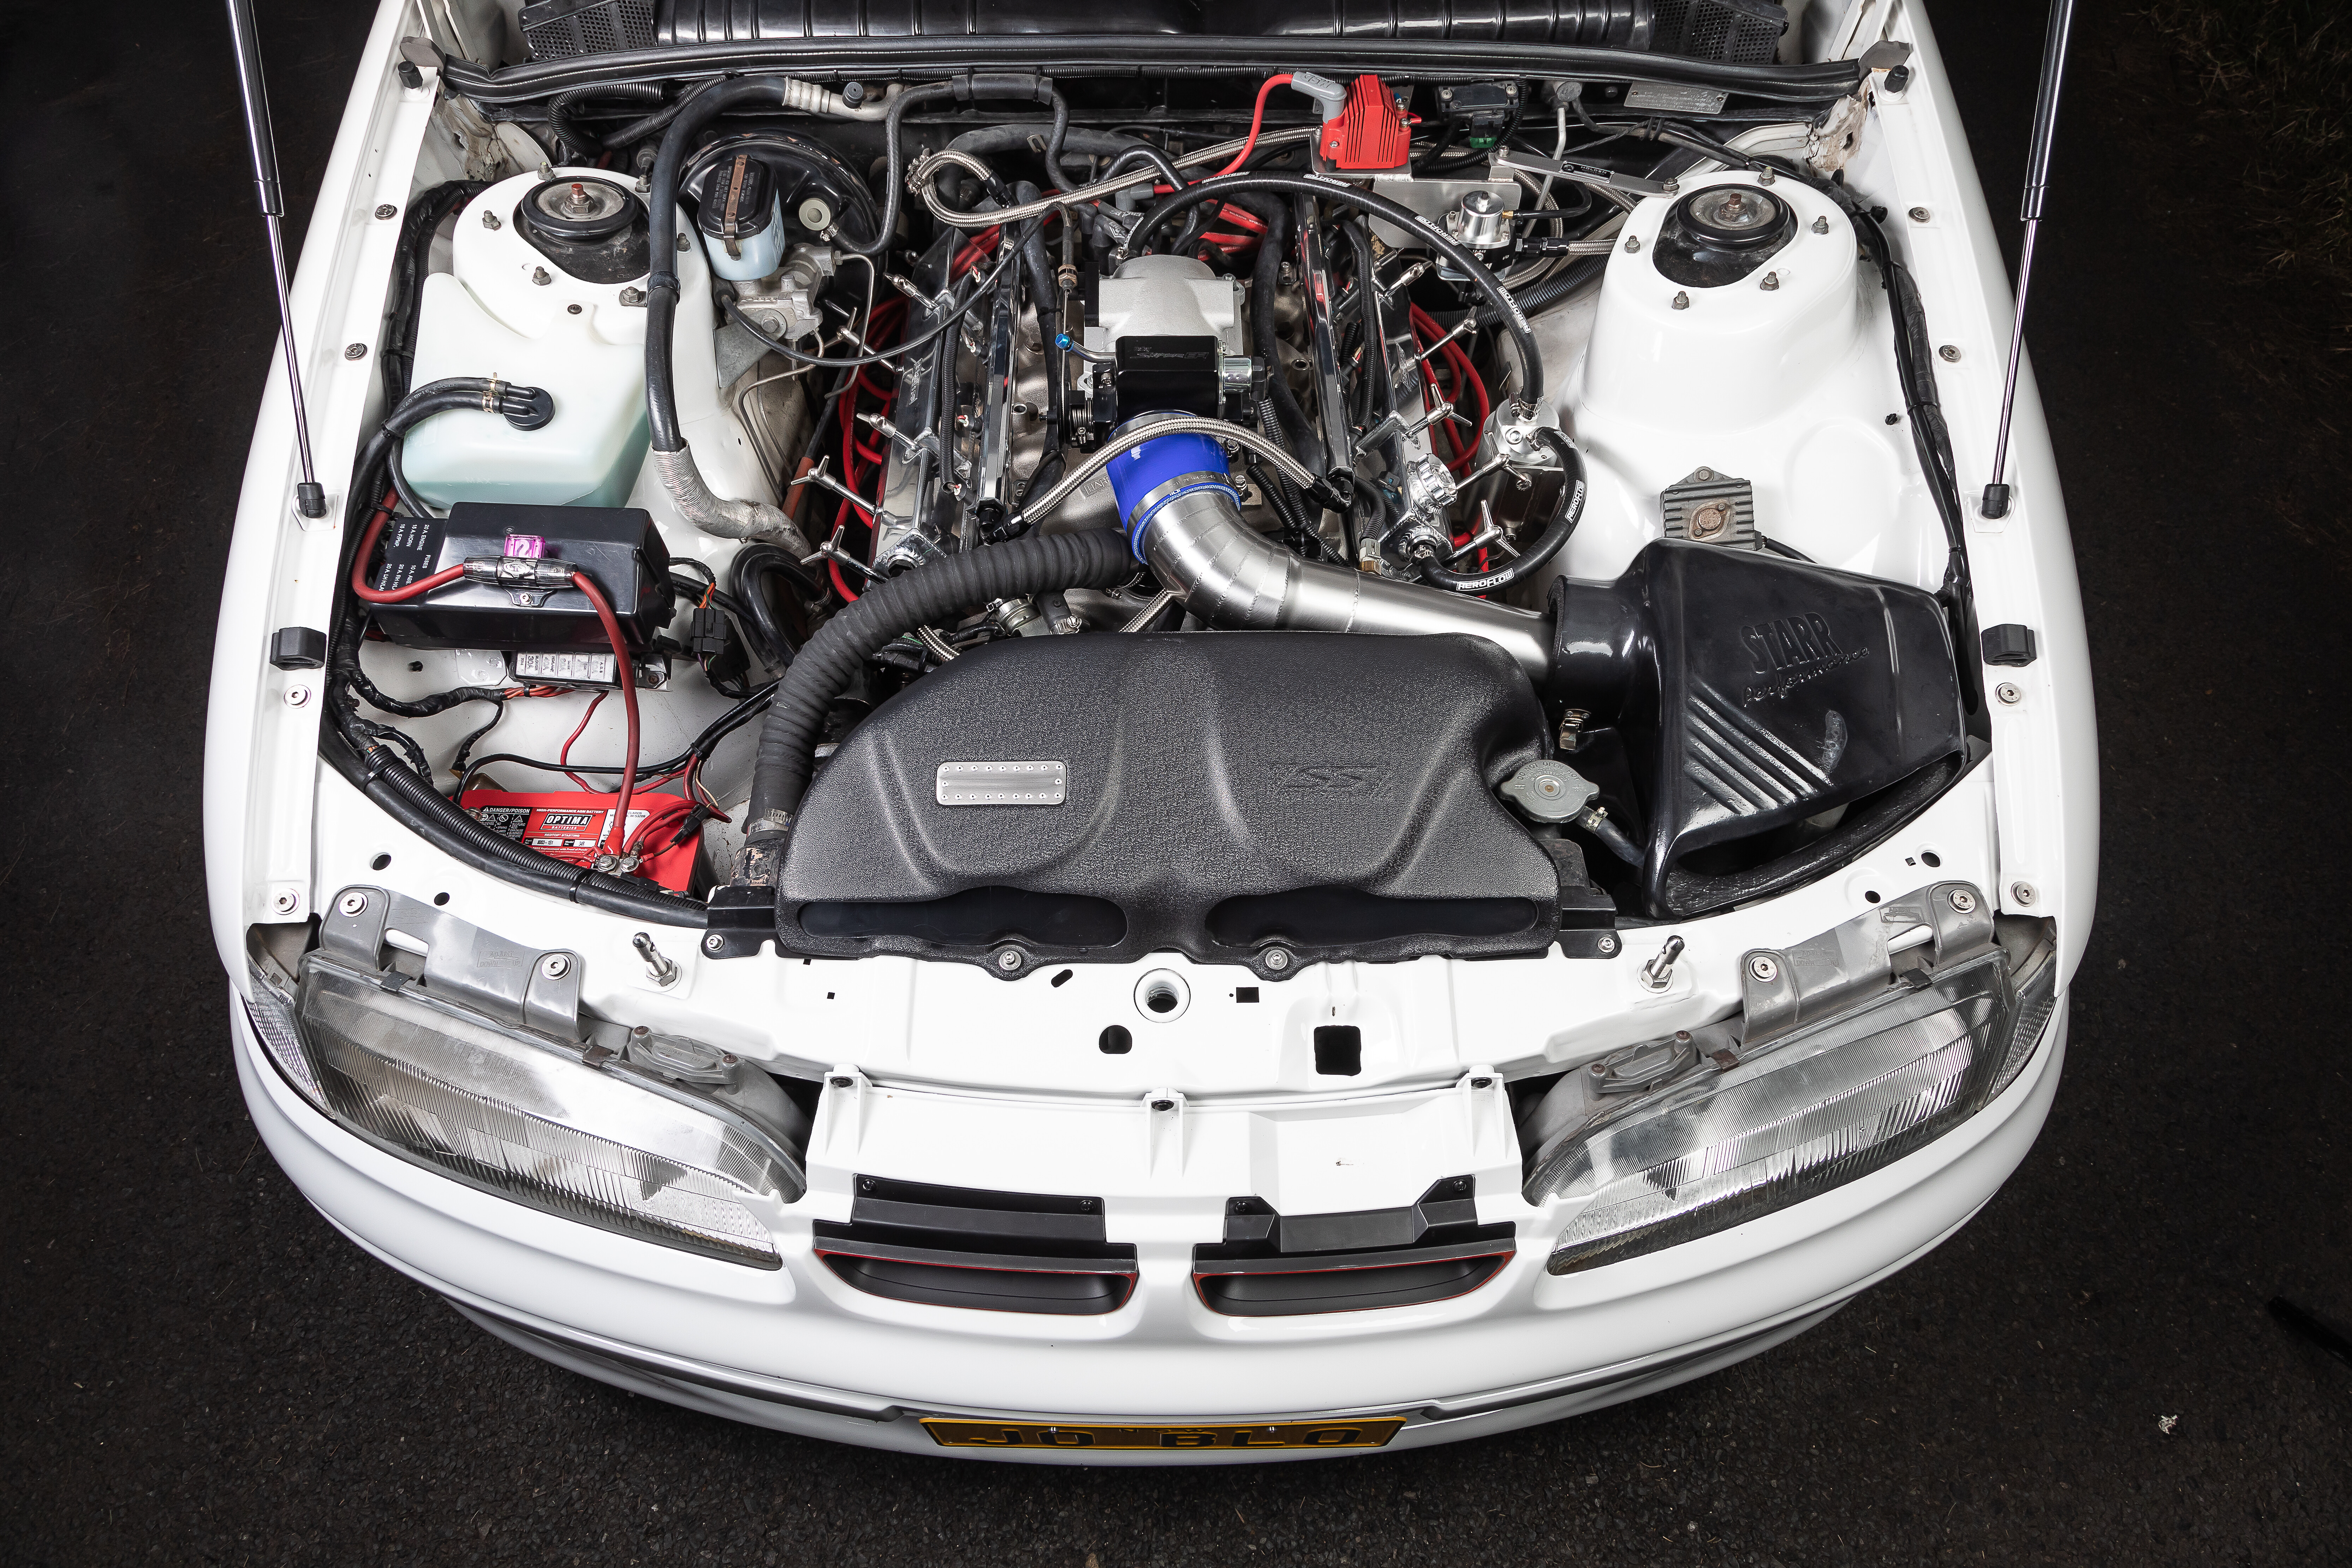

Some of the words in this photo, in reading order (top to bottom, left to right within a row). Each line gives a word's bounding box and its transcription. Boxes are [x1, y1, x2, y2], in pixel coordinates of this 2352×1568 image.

[1581, 166, 1607, 174] HOLDEN
[1417, 216, 1459, 245] AEROFLOW
[1498, 287, 1531, 332] AEROFLOW
[1567, 481, 1584, 522] AEROFLOW
[406, 534, 415, 547] HORN
[417, 535, 427, 551] ENGINE
[422, 554, 431, 568] FUSES
[1458, 570, 1513, 590] AEROFLOW
[1739, 612, 1843, 674] STARR
[1517, 772, 1526, 780] DO
[1524, 763, 1538, 771] NOT
[1543, 762, 1564, 770] OPEN
[1567, 769, 1580, 781] HOT
[546, 816, 588, 825] OPTIMA
[1160, 1427, 1363, 1447] BLO
